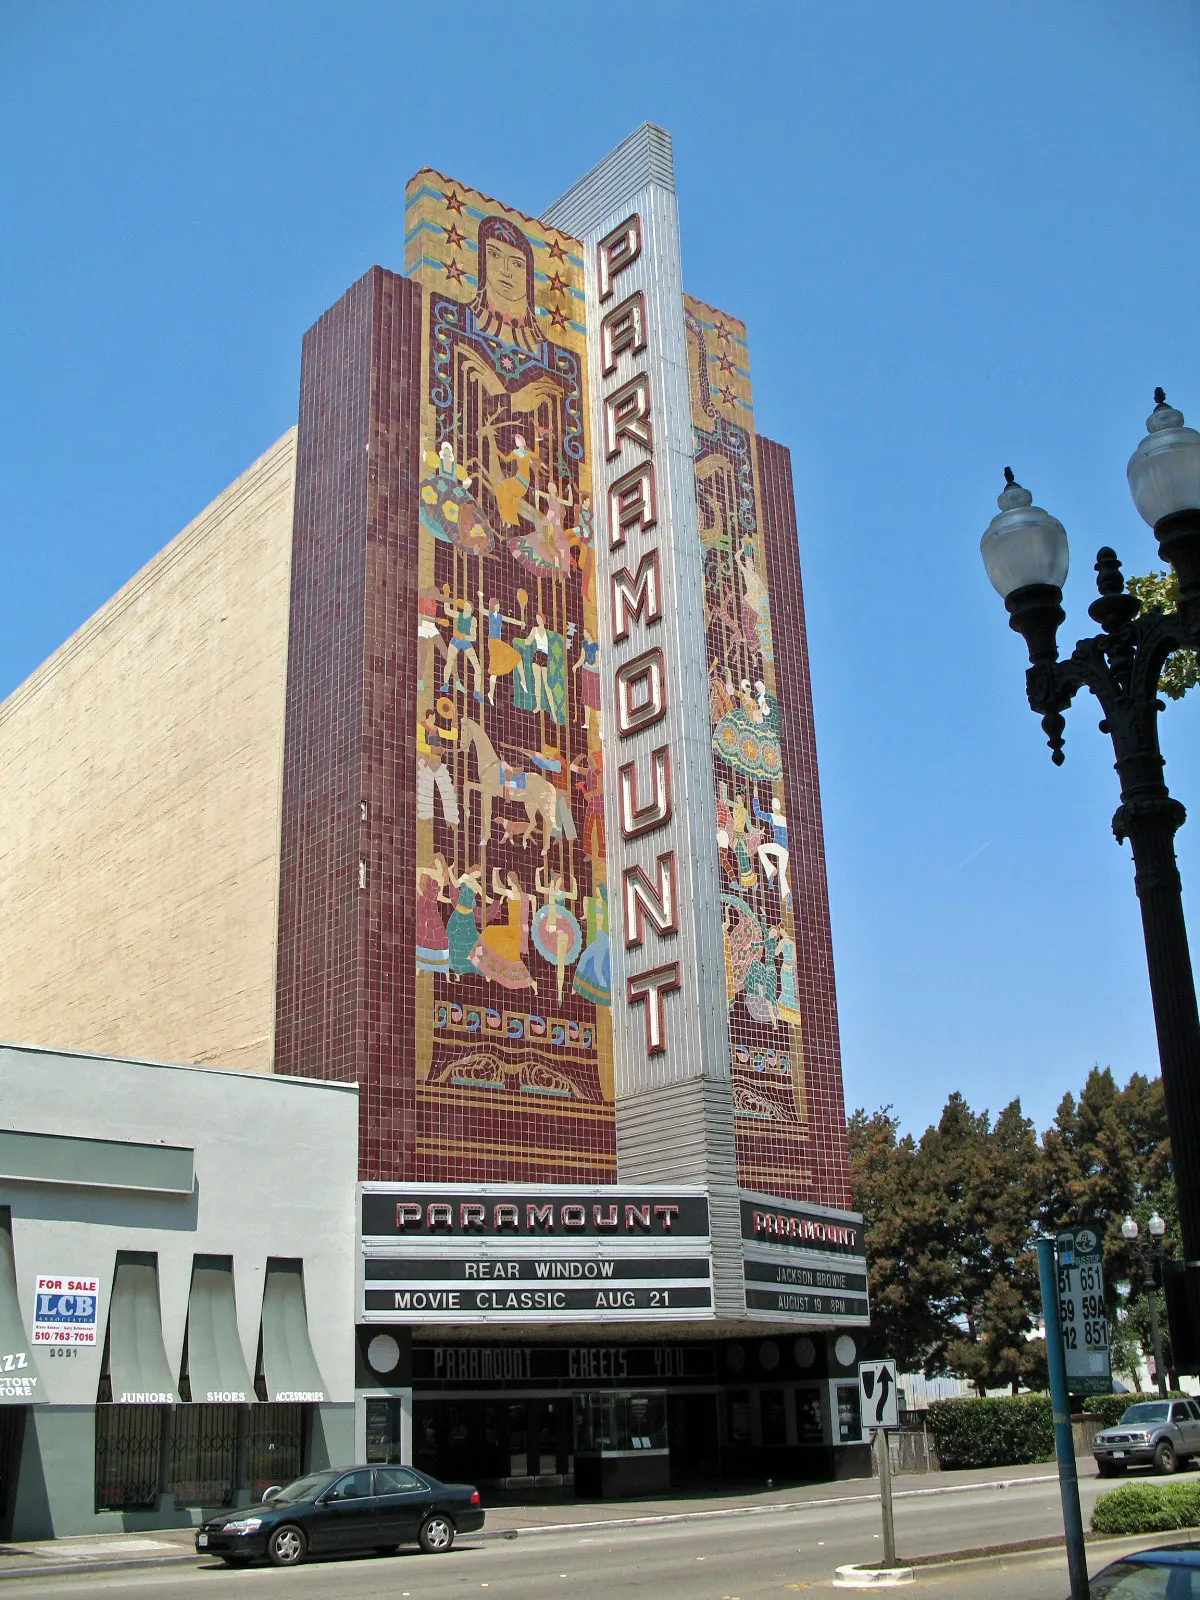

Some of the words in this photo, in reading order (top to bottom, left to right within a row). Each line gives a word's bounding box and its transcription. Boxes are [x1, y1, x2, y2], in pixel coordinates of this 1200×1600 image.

[597, 212, 682, 1057] PARAMOUNT
[396, 1202, 679, 1229] PARAMOUNT
[753, 1210, 857, 1247] PARAMOUNT
[465, 1262, 520, 1279] REAR
[535, 1261, 615, 1278] WINDOW
[776, 1267, 813, 1285] JACKSON
[816, 1272, 846, 1288] BROWNE
[1058, 1269, 1072, 1293] 51
[1080, 1264, 1101, 1292] 651
[38, 1279, 62, 1290] FOR
[67, 1280, 96, 1291] SALE
[38, 1294, 94, 1317] LCB
[394, 1292, 461, 1309] MOVIE
[476, 1291, 566, 1308] CLASSIC
[595, 1291, 636, 1307] AUG
[649, 1290, 670, 1306] 21
[778, 1295, 809, 1312] AUGUST
[813, 1298, 822, 1312] 19
[831, 1299, 846, 1313] 8PM
[1059, 1299, 1075, 1322] 59
[1082, 1294, 1106, 1321] 59A
[35, 1331, 94, 1342] 510/763-7016
[1084, 1320, 1108, 1345] 851
[0, 1352, 28, 1372] ZZ
[49, 1348, 77, 1358] 2021
[433, 1347, 532, 1380] PARAMOUNT
[568, 1347, 628, 1378] GREETS
[654, 1347, 684, 1377] YOU
[120, 1392, 174, 1403] JUNIORS
[206, 1391, 246, 1402] SHOES
[275, 1391, 324, 1402] ACCESSORIES
